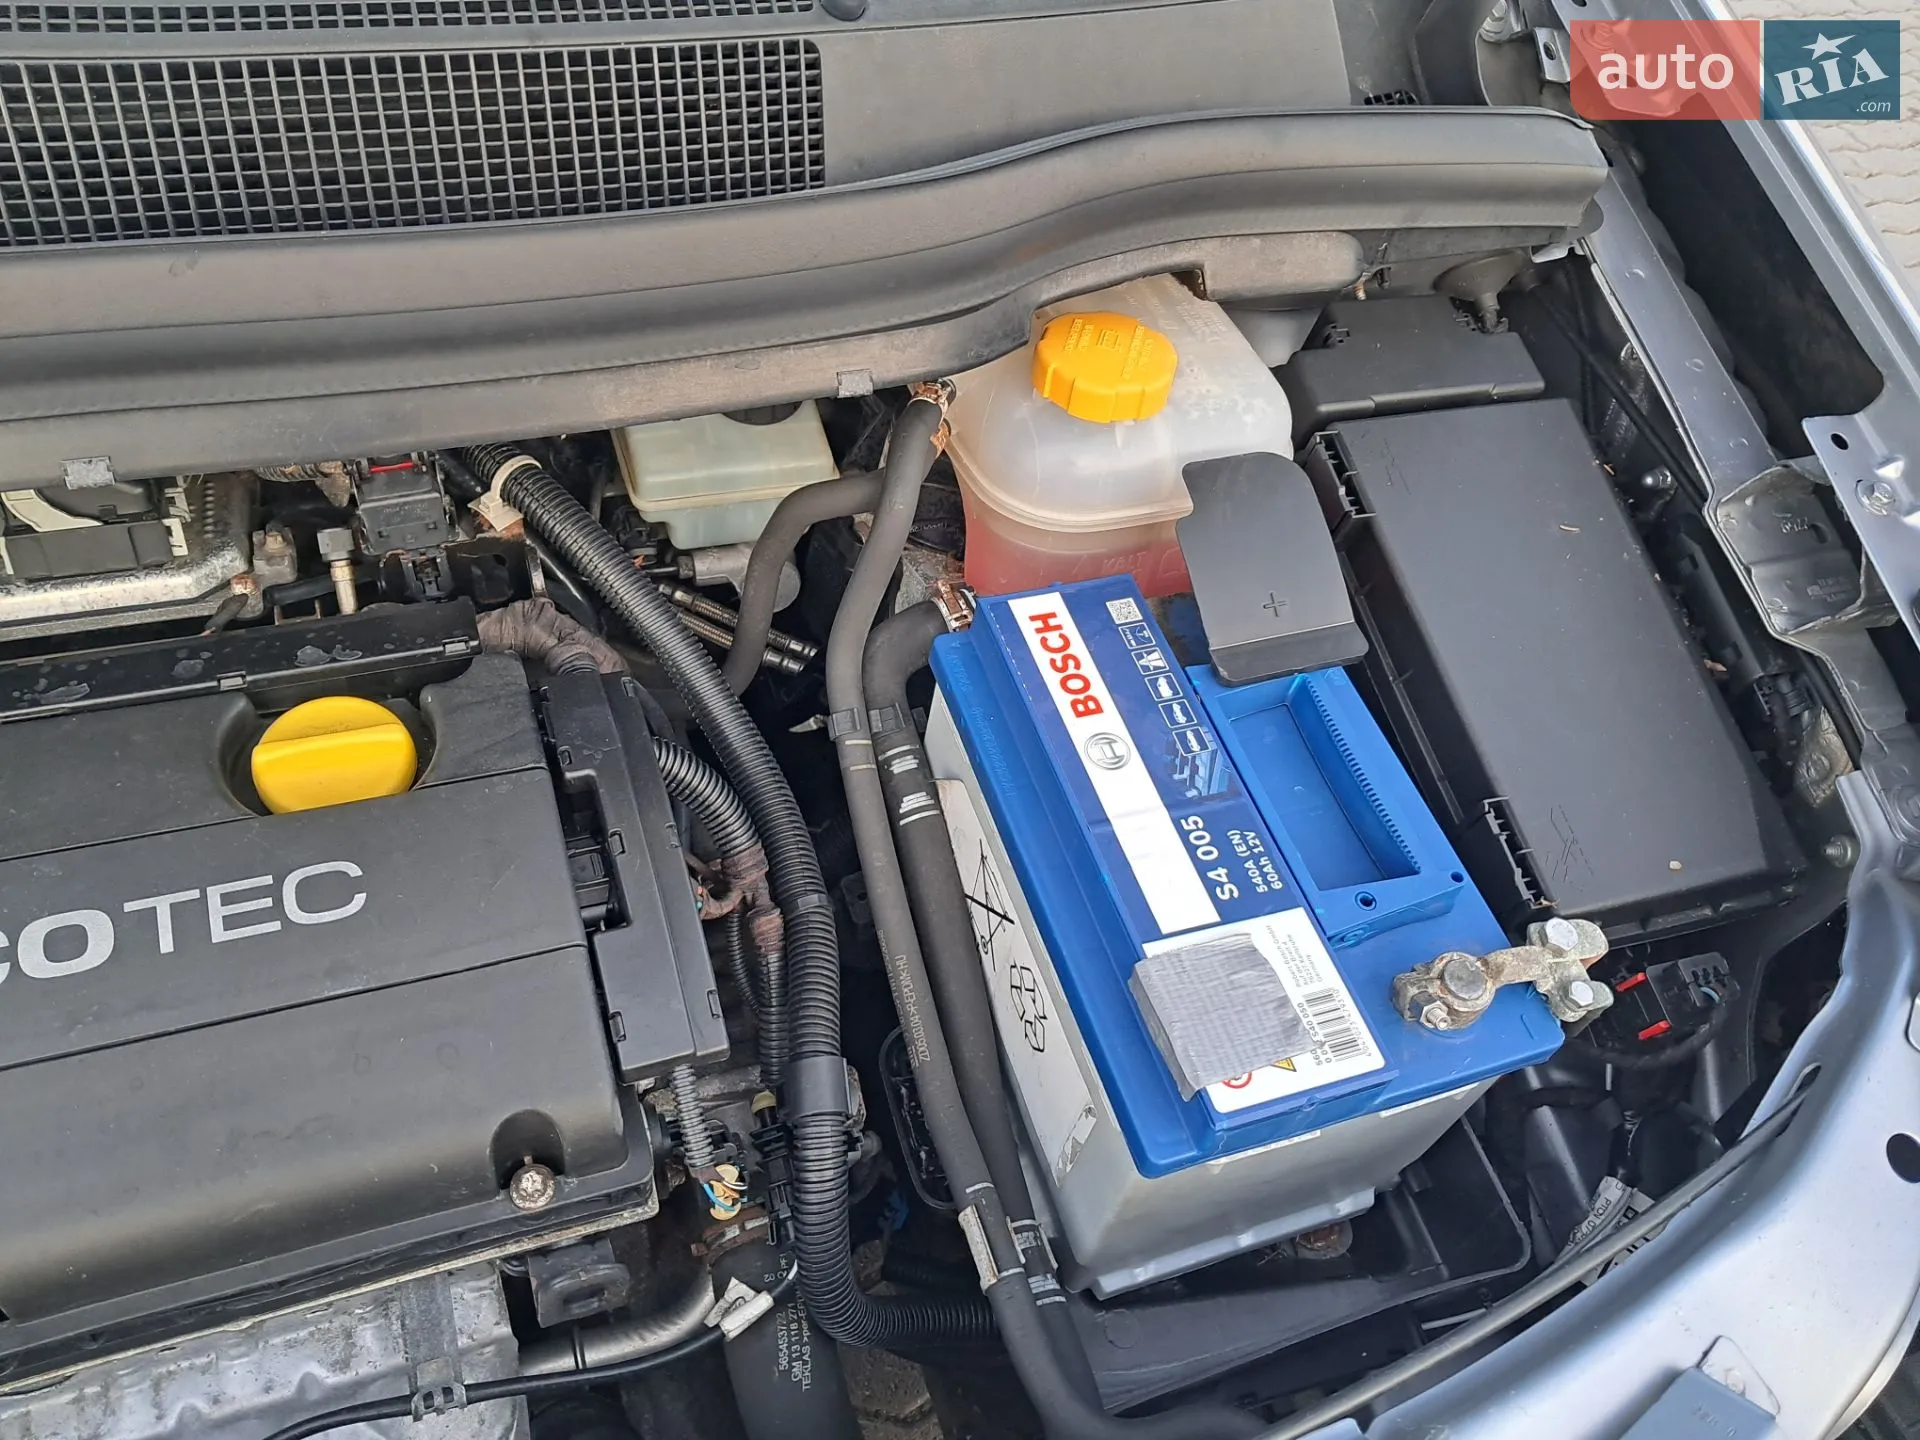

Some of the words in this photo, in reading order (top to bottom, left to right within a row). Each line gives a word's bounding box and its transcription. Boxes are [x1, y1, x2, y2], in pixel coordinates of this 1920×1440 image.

[1028, 612, 1104, 718] BOSCH
[1180, 815, 1219, 861] 005
[1227, 829, 1251, 857] (EN)
[1243, 831, 1265, 854] 12V
[1206, 866, 1239, 901] S4
[1243, 859, 1268, 893] 540A
[1259, 856, 1283, 890] 60Ah
[791, 1361, 802, 1382] GM
[801, 1345, 811, 1392] TEKLAS
